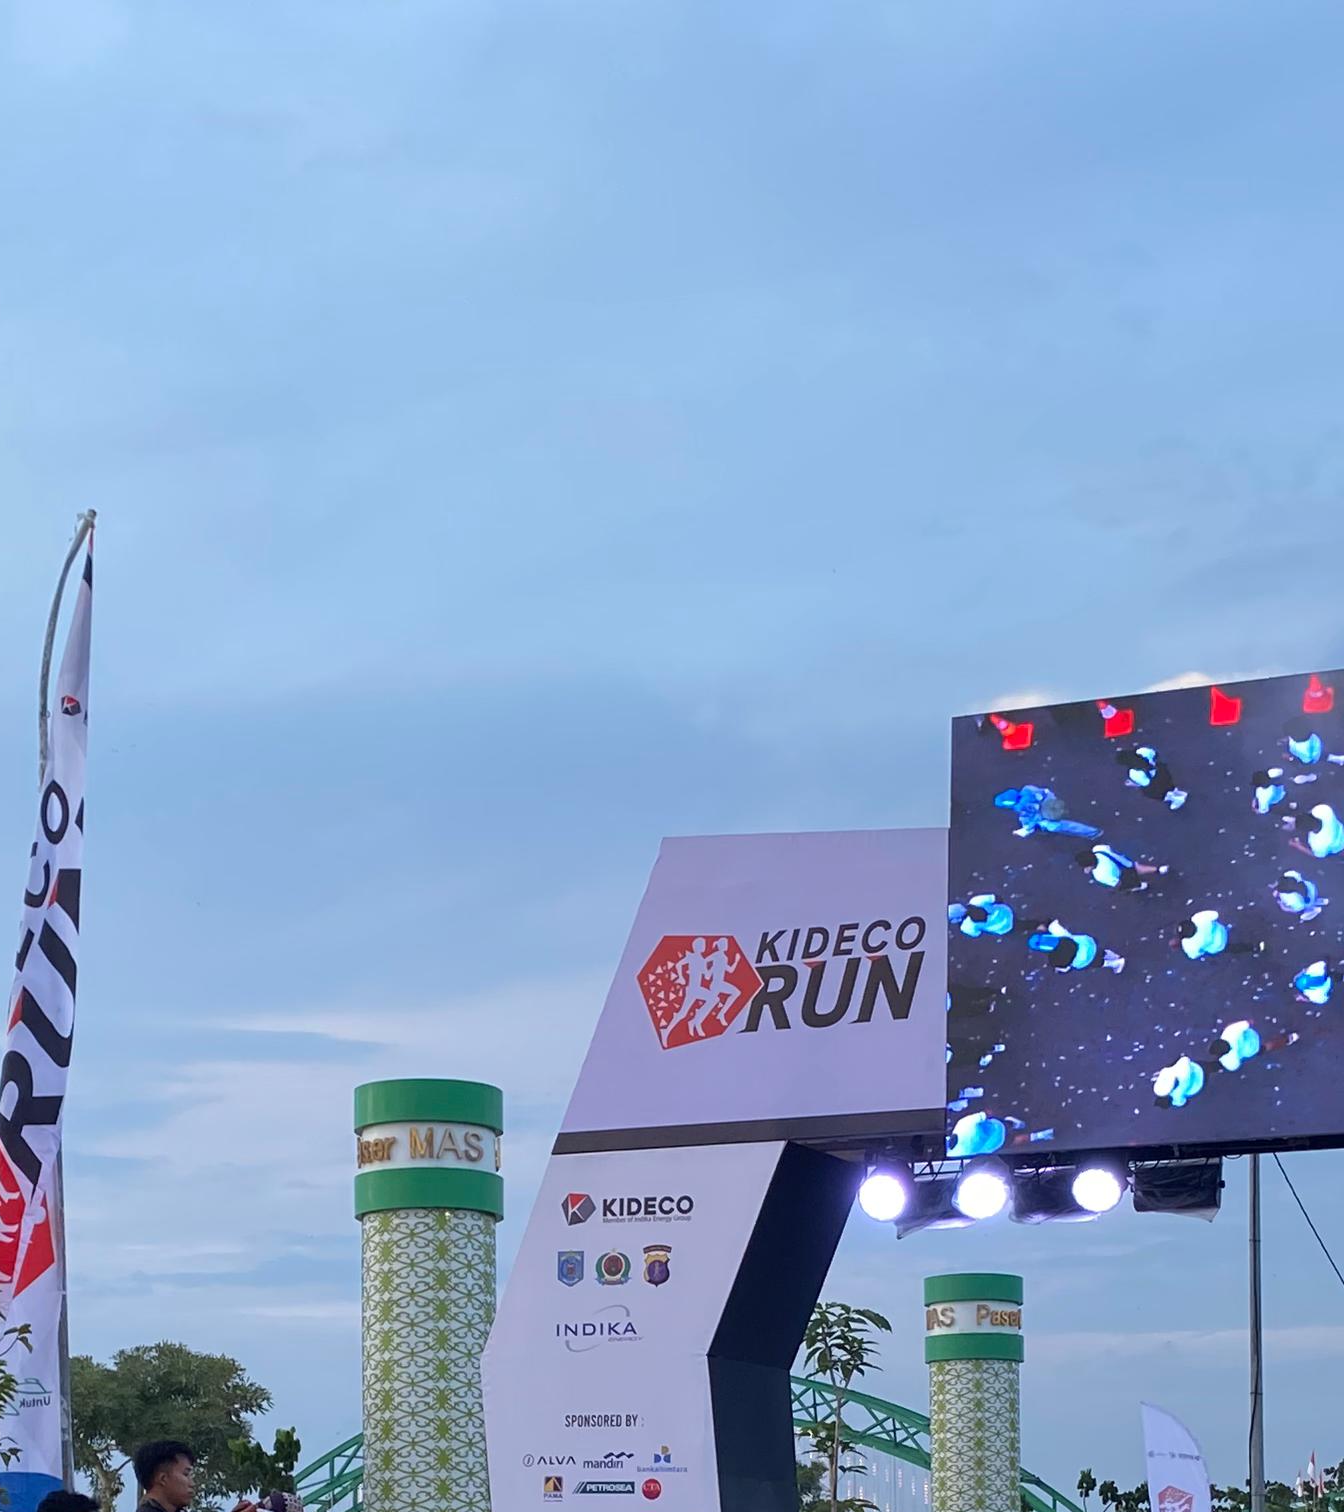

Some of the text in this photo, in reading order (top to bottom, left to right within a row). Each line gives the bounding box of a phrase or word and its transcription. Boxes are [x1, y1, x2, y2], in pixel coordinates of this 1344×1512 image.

[755, 916, 927, 963] KIDECO
[737, 951, 926, 1034] RUN
[409, 1127, 484, 1162] MAS
[603, 1195, 694, 1217] KIDECO
[557, 1322, 637, 1337] INDIKA
[565, 1415, 622, 1428] SPONSORED
[626, 1414, 638, 1427] BY
[537, 1456, 576, 1465] ALVA
[583, 1458, 623, 1469] mandiri
[586, 1484, 633, 1492] PETROSEA
